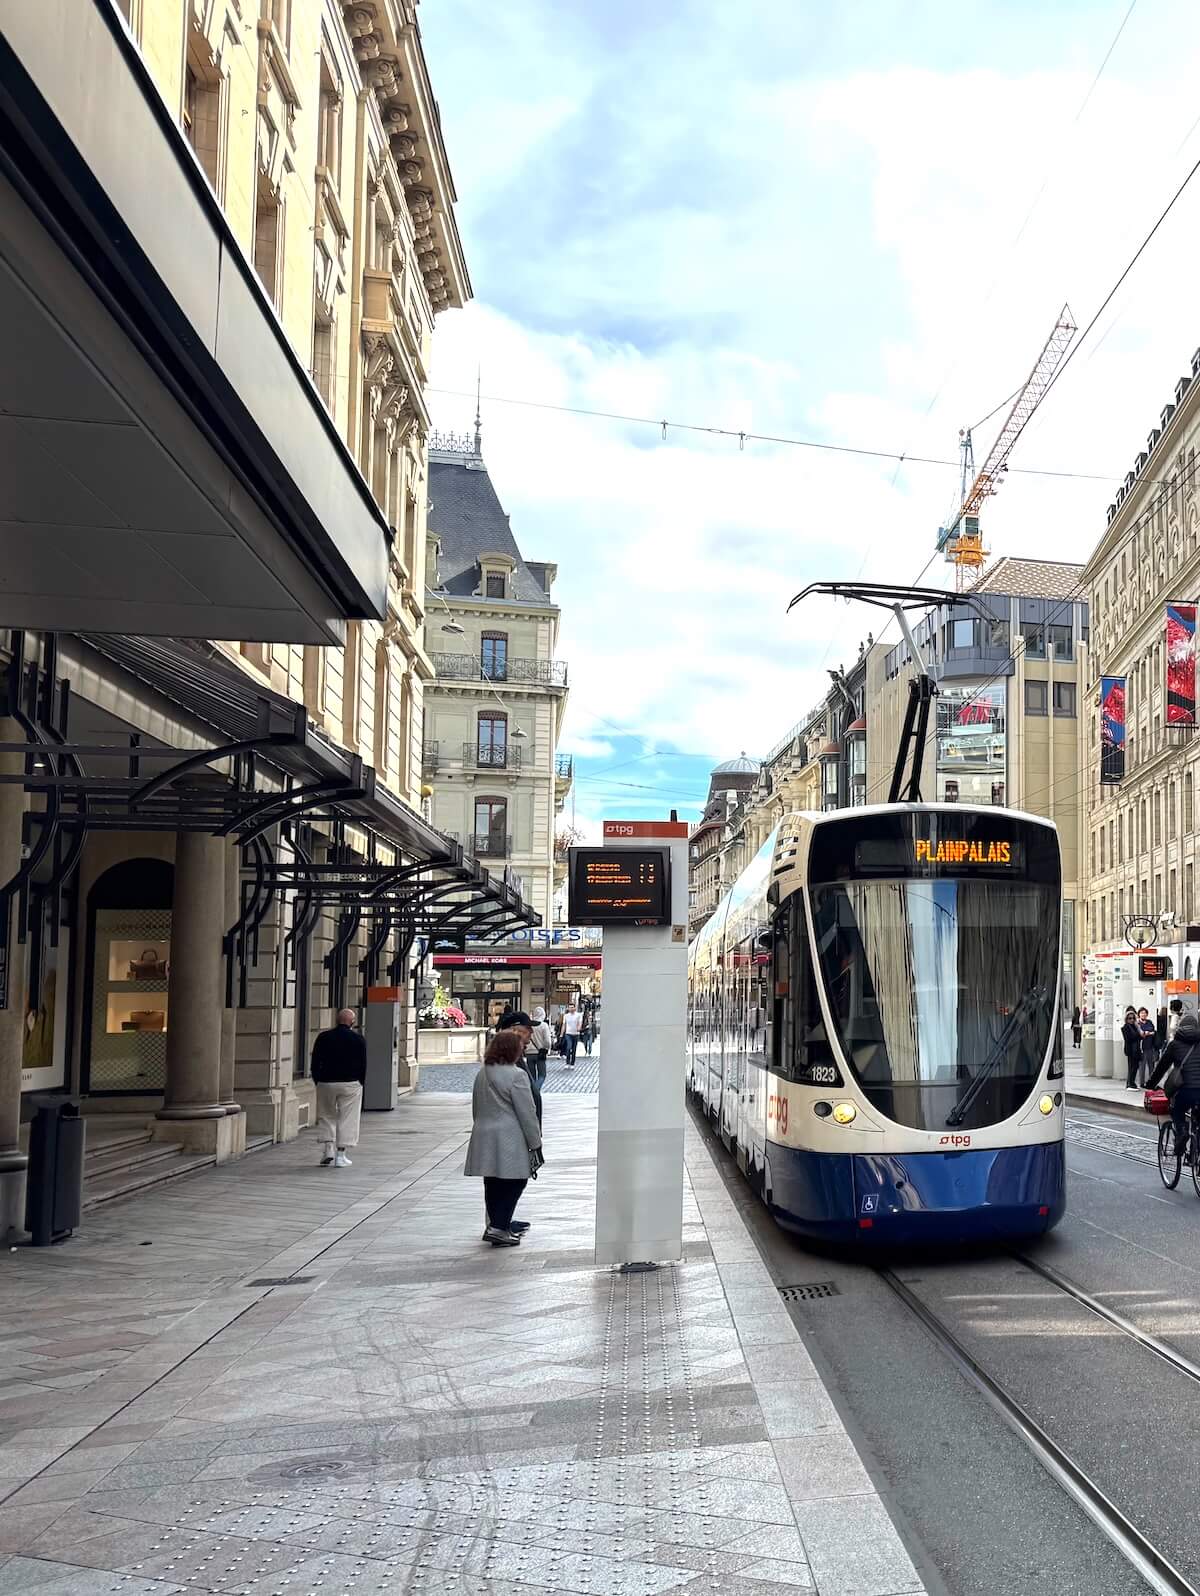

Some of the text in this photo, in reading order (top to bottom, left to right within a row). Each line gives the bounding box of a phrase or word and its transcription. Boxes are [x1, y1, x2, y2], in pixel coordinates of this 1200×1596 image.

[615, 824, 634, 835] tpg
[916, 840, 1010, 863] PLAINPALAIS
[811, 1065, 837, 1083] 1823
[951, 1134, 971, 1147] tpg
